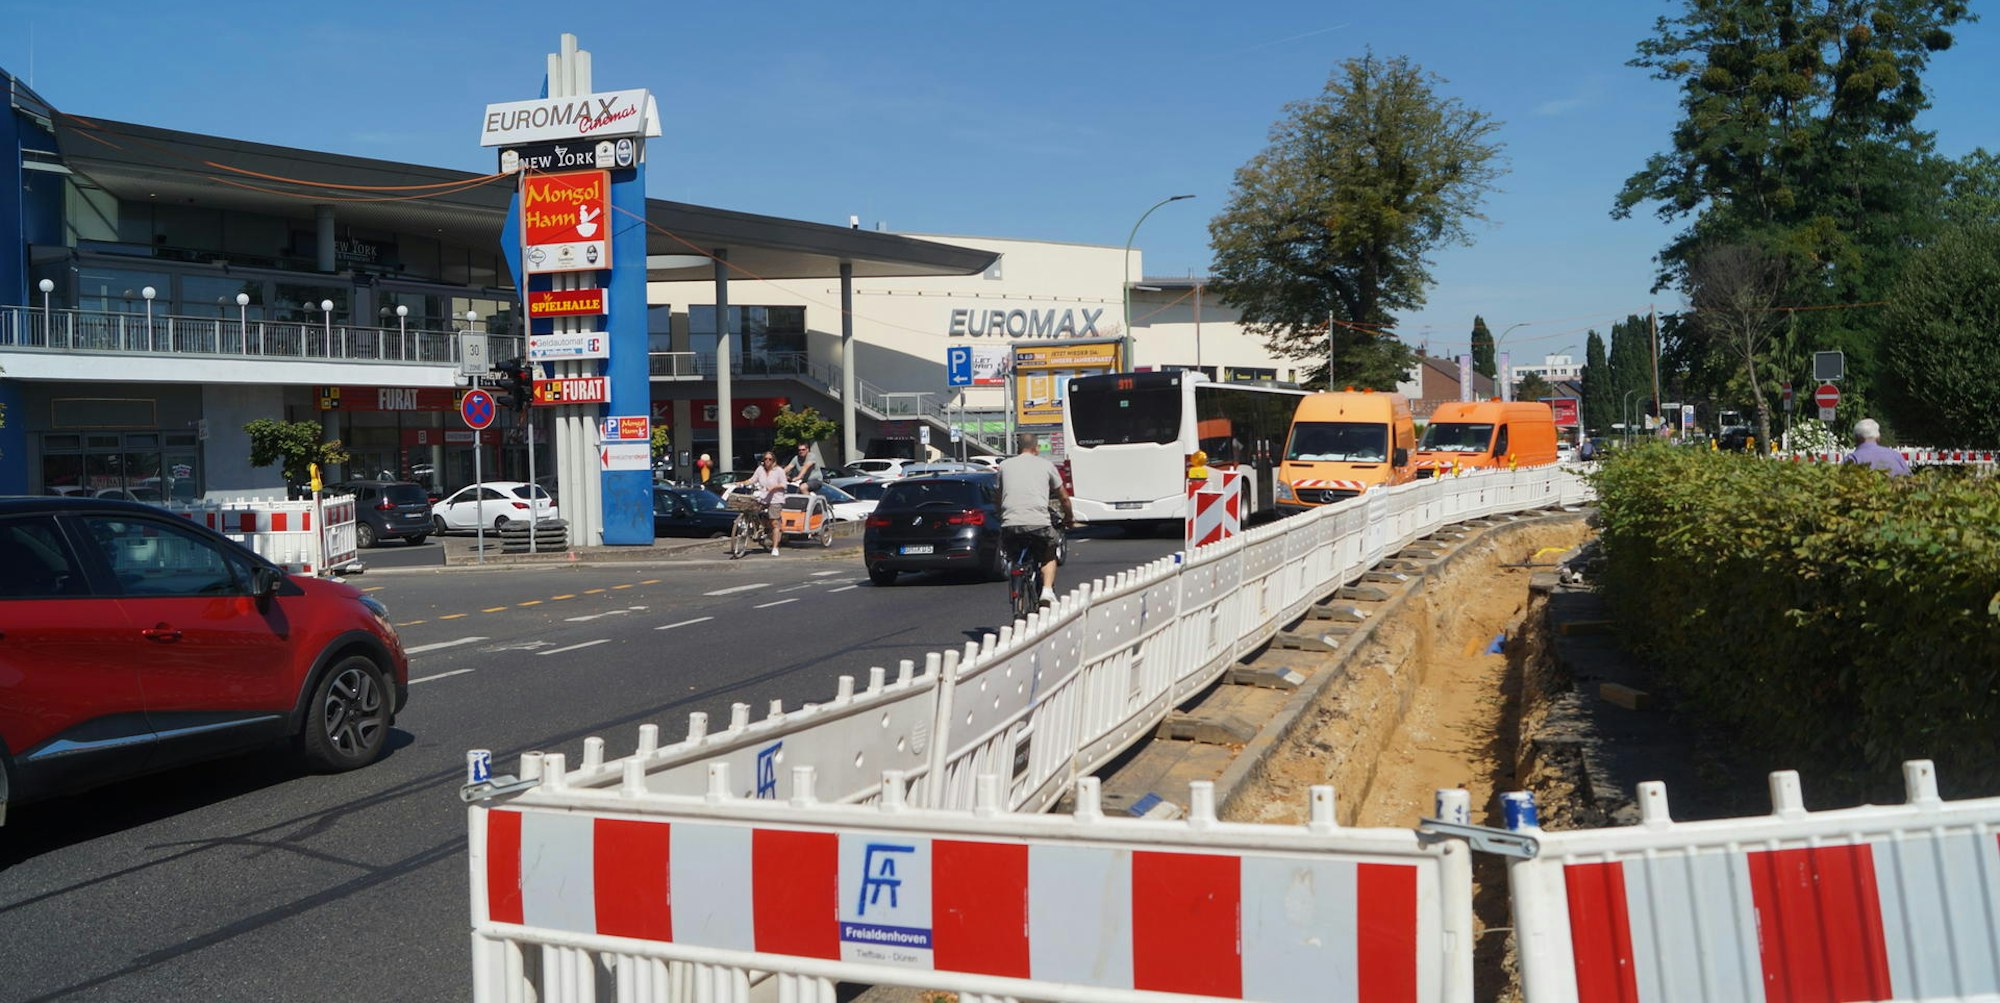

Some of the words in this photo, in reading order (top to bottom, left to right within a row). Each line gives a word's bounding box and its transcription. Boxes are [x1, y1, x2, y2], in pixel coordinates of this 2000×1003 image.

[486, 96, 618, 132] EUROMAX
[579, 103, 638, 134] Cinemas
[519, 155, 552, 169] NEW
[554, 146, 594, 167] YORK
[526, 180, 599, 208] Mongol
[526, 210, 576, 229] Hann
[531, 299, 601, 313] SPIELHALLE
[949, 308, 1104, 338] EUROMAX
[469, 344, 480, 356] 30
[537, 337, 584, 347] Geldautomat
[588, 338, 600, 352] EC
[952, 350, 966, 373] P
[562, 379, 603, 401] FURAT
[1118, 378, 1133, 389] 911
[378, 388, 419, 410] FURAT
[607, 419, 617, 432] P
[845, 926, 927, 945] Freialdenhoven
[856, 949, 886, 961] Tiefbau
[893, 952, 918, 963] Düren
